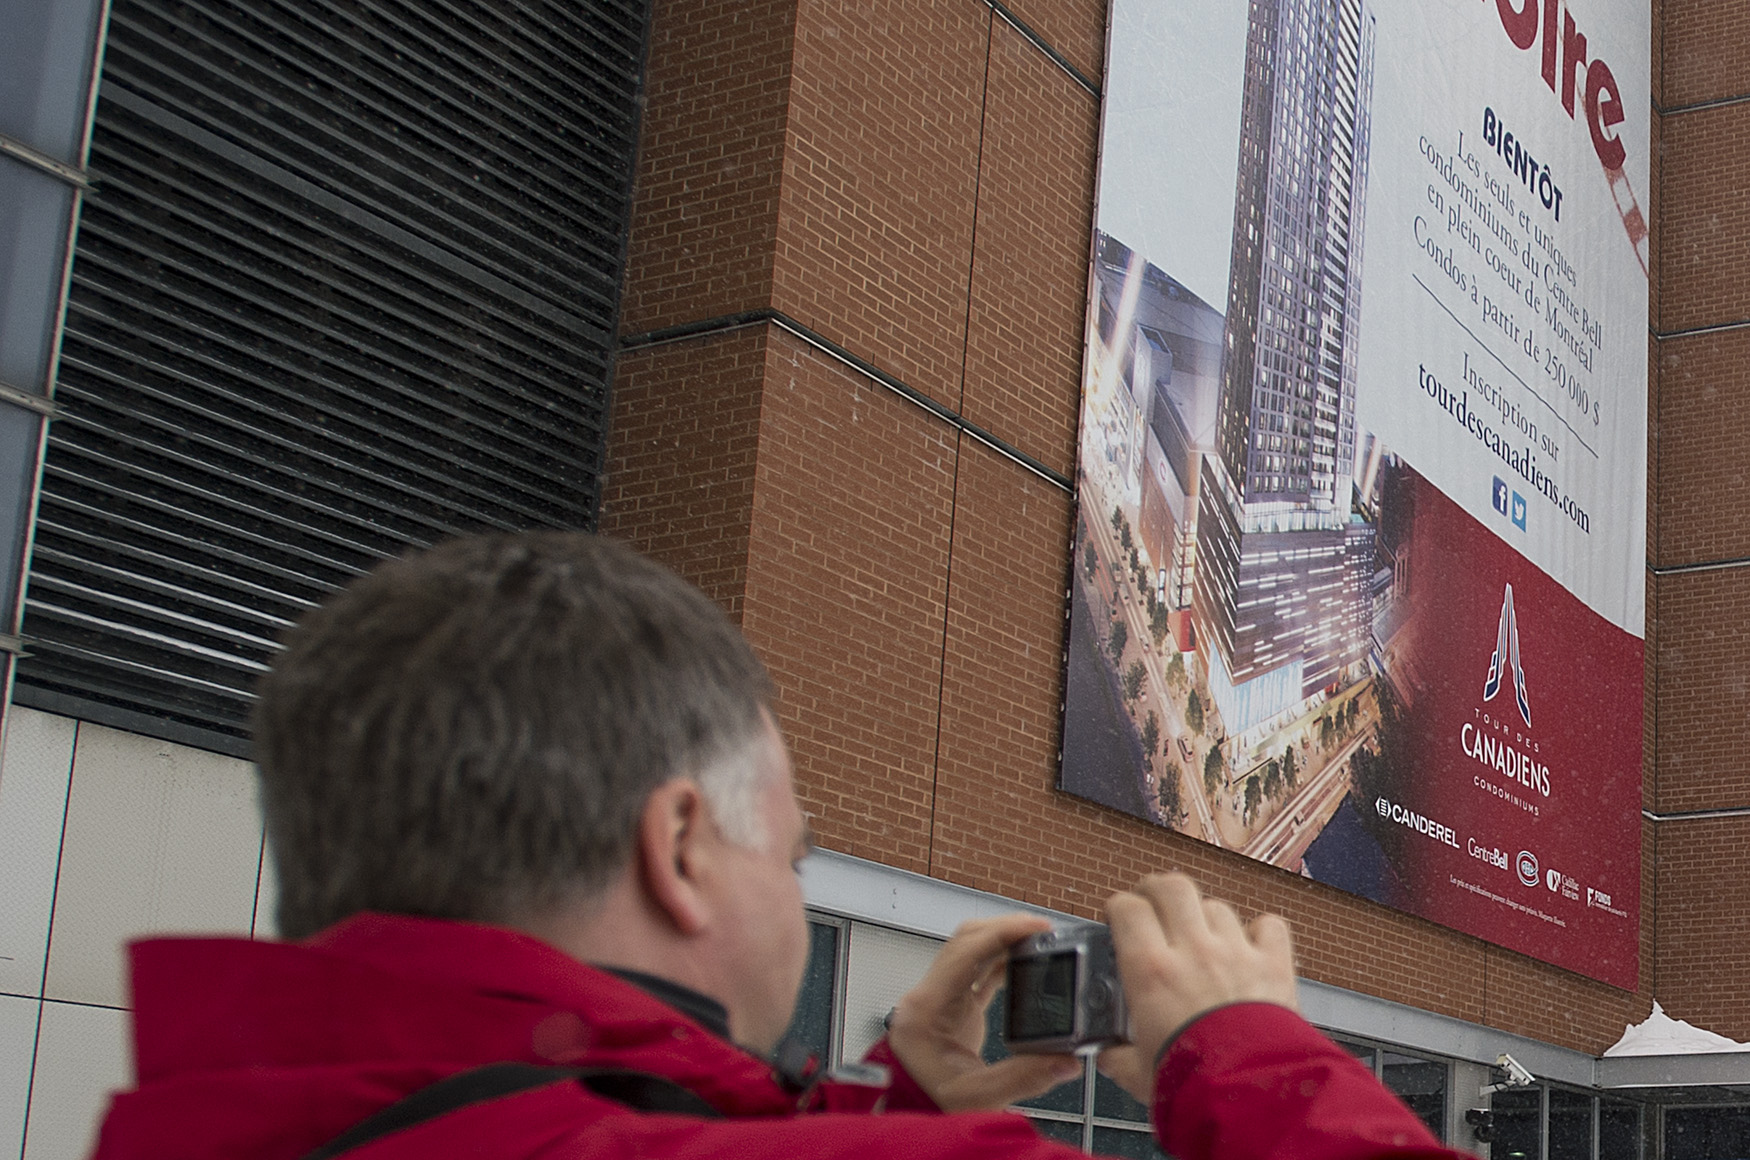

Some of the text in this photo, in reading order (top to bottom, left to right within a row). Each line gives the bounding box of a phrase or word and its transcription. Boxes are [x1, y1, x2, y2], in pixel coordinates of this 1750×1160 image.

[1457, 130, 1577, 288] Les seuls et uniques
[1483, 106, 1562, 222] BIENTÔT
[1419, 136, 1602, 351] condominiums du Centre Bell
[1428, 183, 1594, 374] en plein coeur de Montréal
[1414, 215, 1467, 292] Condos
[1471, 274, 1478, 304] à
[1482, 294, 1521, 346] partir
[1523, 329, 1540, 363] de
[1592, 401, 1600, 427] $
[1418, 362, 1590, 535] tourdescanadiens.com
[1462, 352, 1559, 463] Inscription sur
[1461, 722, 1550, 797] CANADIENS
[1474, 707, 1540, 753] TOUR DES
[1392, 804, 1460, 849] CANDEREL
[1474, 775, 1540, 817] CONDOMINIUMS
